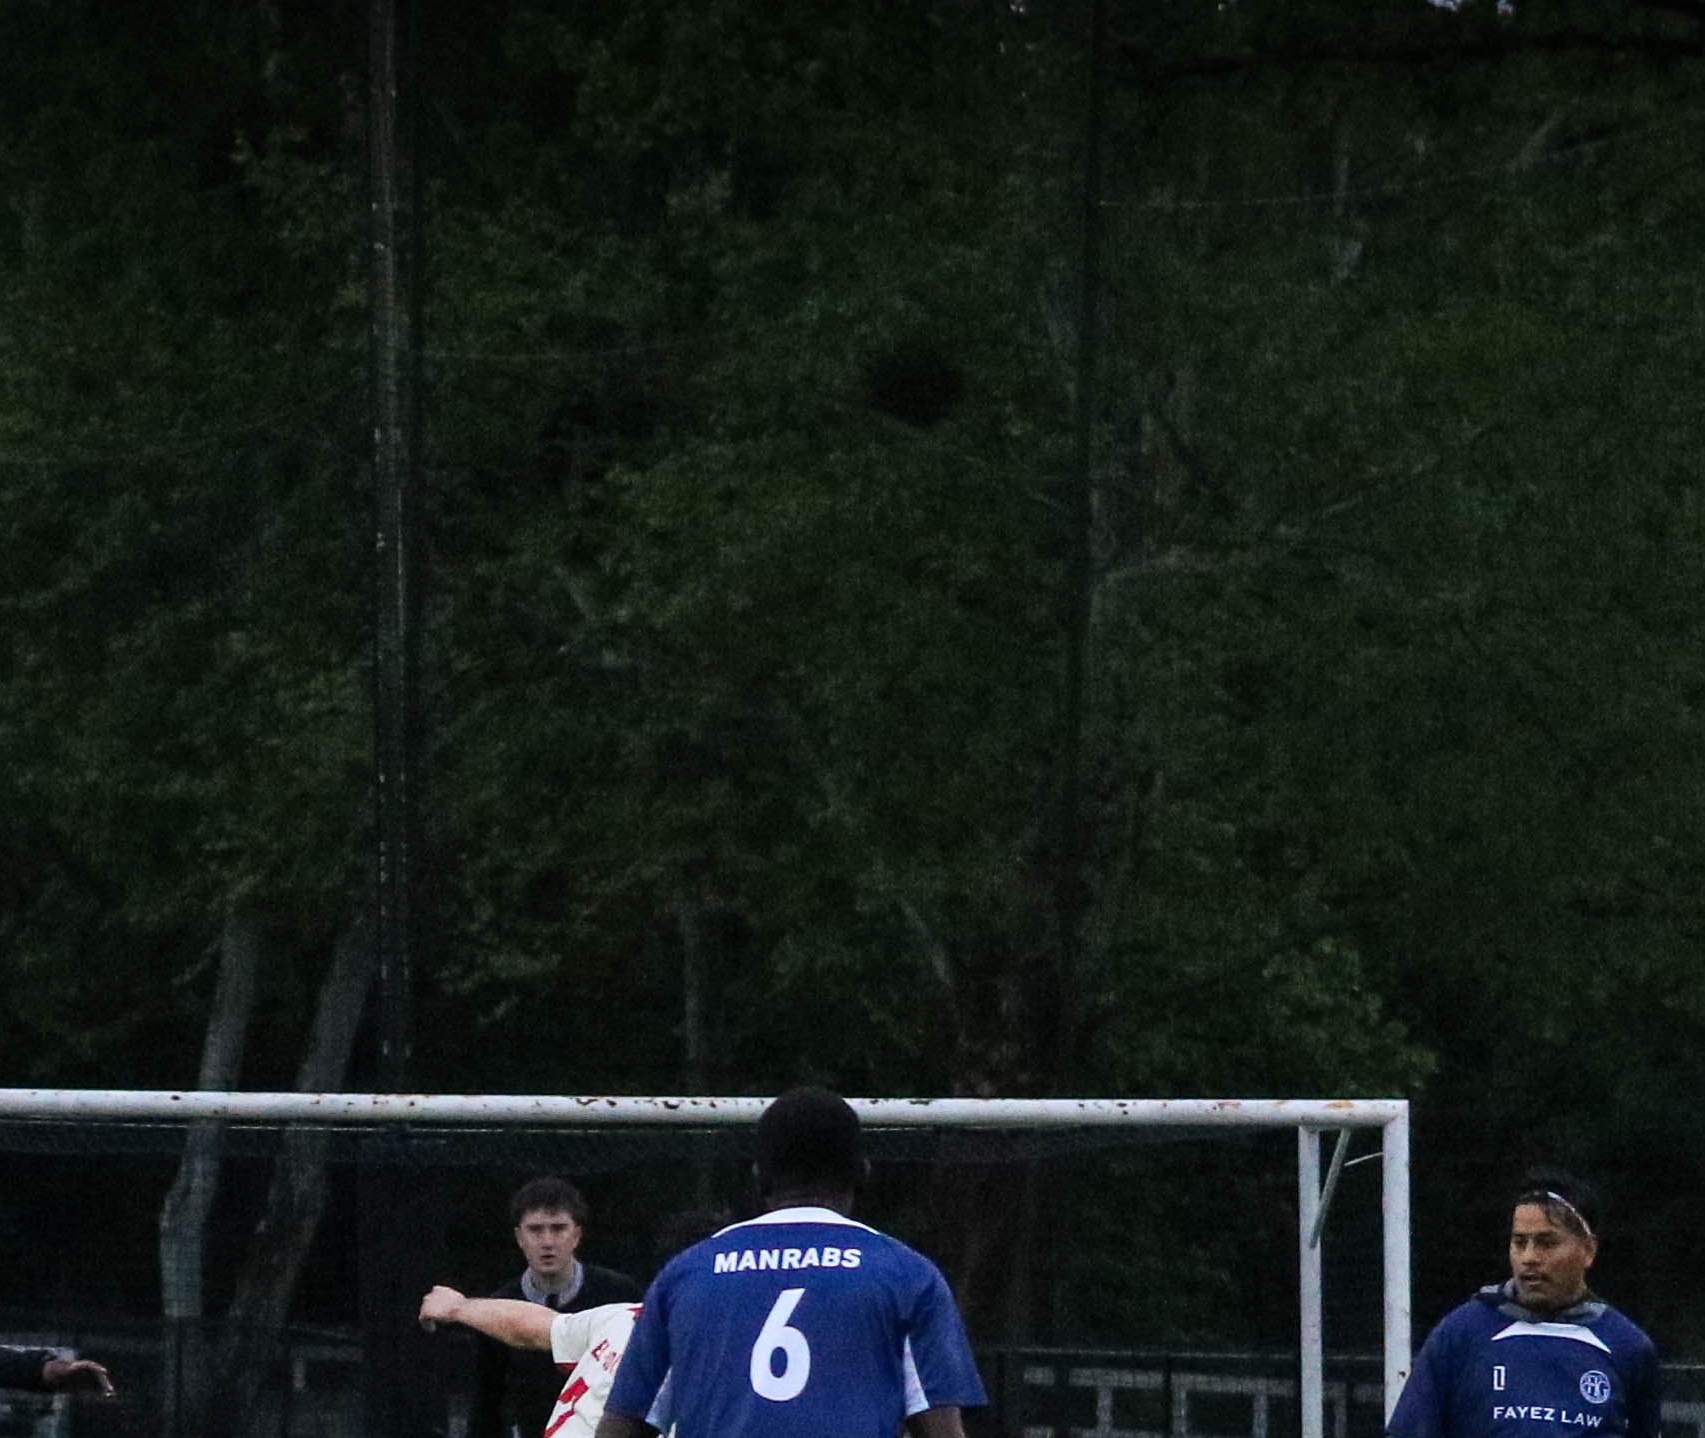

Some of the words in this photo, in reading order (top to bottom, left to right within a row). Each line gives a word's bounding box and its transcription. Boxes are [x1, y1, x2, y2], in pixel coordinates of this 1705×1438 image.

[713, 1247, 862, 1274] MANRABS
[750, 1287, 811, 1402] 6
[1493, 1406, 1555, 1421] FAYEZ
[1560, 1410, 1603, 1428] LAW
